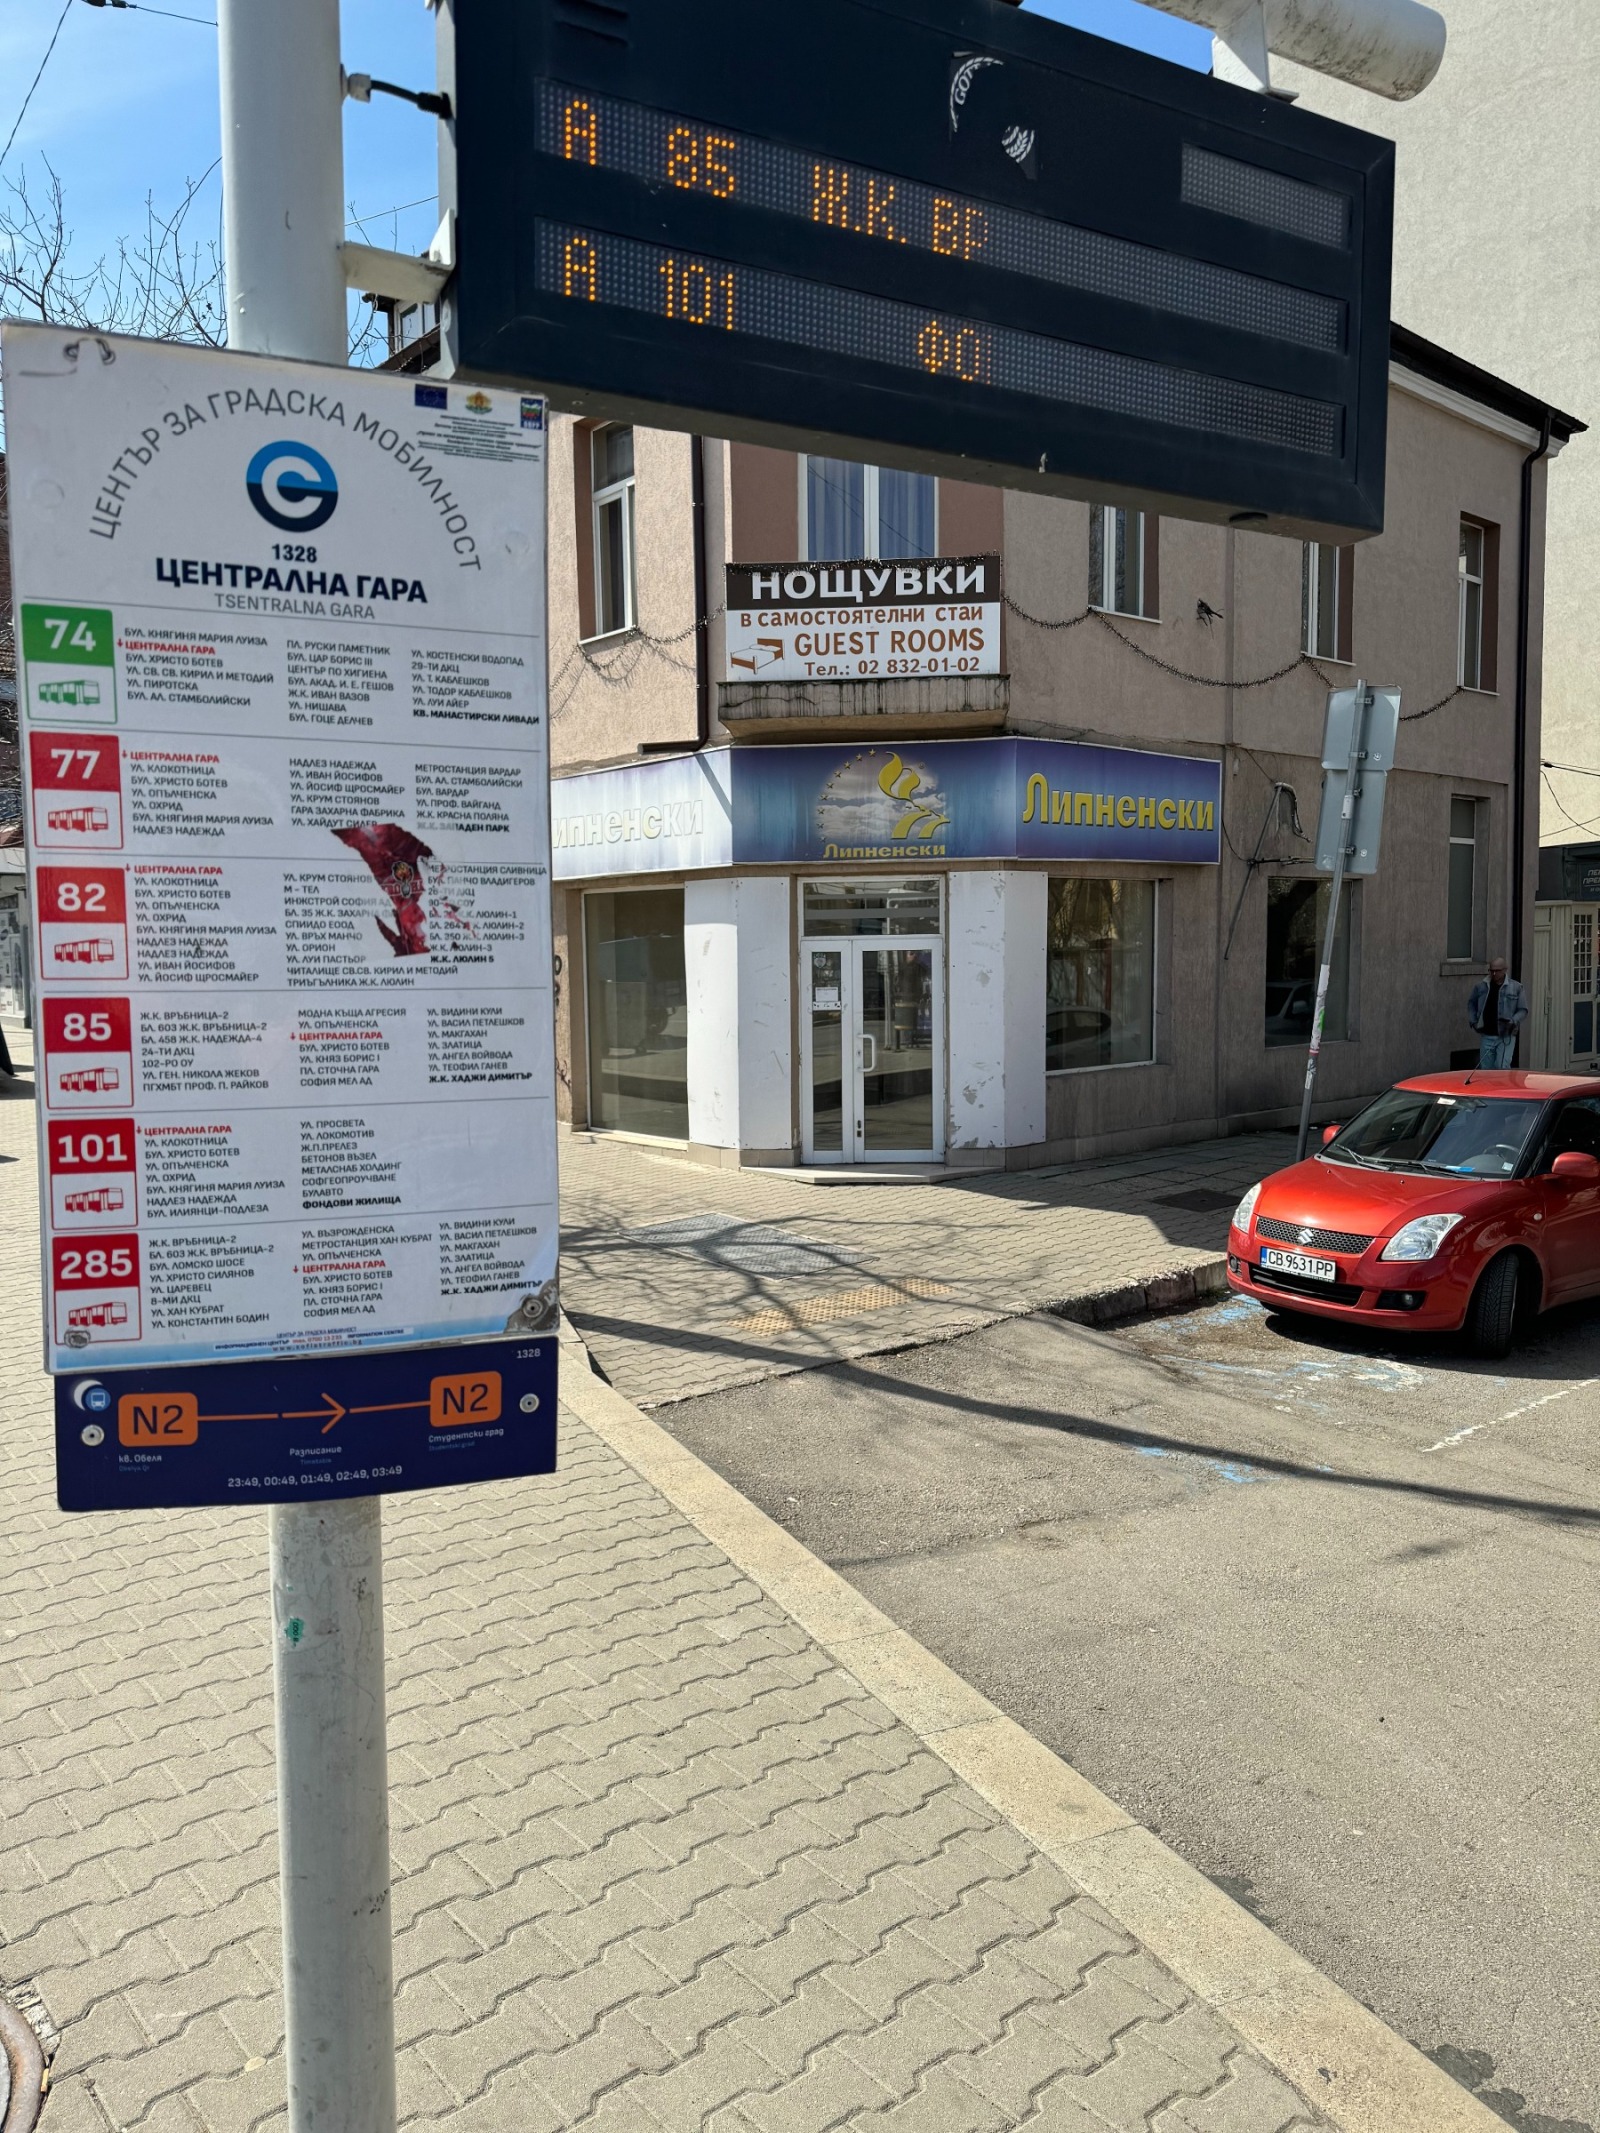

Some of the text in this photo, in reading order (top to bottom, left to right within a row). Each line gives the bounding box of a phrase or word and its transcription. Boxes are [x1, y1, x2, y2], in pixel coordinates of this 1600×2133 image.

[668, 127, 735, 198] 85
[814, 164, 907, 244] Ж.К.
[660, 258, 734, 330] 101
[89, 426, 161, 540] ЦЕНТЪР
[163, 403, 206, 437] ЗА
[207, 388, 346, 427] ГРАДСКА
[352, 411, 482, 573] МОБИЛНОСТ
[271, 543, 318, 564] 1328
[156, 557, 429, 604] ЦЕНТРАЛНА ГАРА
[752, 565, 985, 603] НОЩУВКИ
[214, 592, 376, 620] TSENTRALNA GARA
[740, 605, 983, 627] в самостоятелни стаи
[44, 618, 96, 652] 74
[124, 628, 267, 646] БУЛ. КНЯГИНЯ МАРИЯ ЛУИЗА
[125, 641, 215, 654] ЦЕНТРАЛНА ГАРА
[794, 627, 985, 657] GUEST ROOMS
[125, 653, 223, 667] БУЛ. ХРИСТО БОТЕВ
[804, 656, 980, 676] Тел.: 02 832-01-02
[287, 664, 387, 678] ЦЕНТЪР ПО ХИГИЕНА
[411, 661, 459, 673] 29-ТИ ДКЦ
[413, 709, 539, 724] КВ. МАНАСТИРСКИ ЛИВАДИ
[51, 748, 101, 779] 77
[130, 752, 219, 763] ЦЕНТРАЛНА ГАРА
[289, 758, 376, 770] НАДЛЕЗ НАДЕЖДА
[130, 764, 215, 775] УЛ. КЛОКОТНИЦА
[414, 764, 521, 776] МЕТРОСТАНЦИЯ ВАРДАР
[415, 787, 469, 797] БУЛ. ВАРДАР
[1022, 772, 1214, 832] Липненски
[291, 805, 404, 817] ГАРА ЗАХАРНА ФАБРИКА
[133, 825, 225, 836] НАДЛЕЗ НАДЕЖДА
[552, 800, 704, 849] ипненски
[822, 842, 947, 859] Липненски
[134, 865, 222, 874] ЦЕНТРАЛНА ГАРА
[134, 877, 218, 886] УЛ. КЛОКОТНИЦА
[57, 882, 106, 912] 82
[328, 920, 354, 929] ЕООД
[136, 938, 228, 948] НАДЛЕЗ НАДЕЖДА
[430, 955, 451, 963] Ж.К.
[488, 955, 494, 963] 5
[138, 972, 259, 982] УЛ. ЙОСИФ ЩРОСМАЙЕР
[287, 978, 357, 986] ТРИЪГЪЛНИКА
[359, 978, 378, 986] Ж.К.
[140, 1011, 228, 1020] Ж.К. ВРЪБНИЦА-2
[298, 1008, 406, 1018] МОДНА КЪЩА АГРЕСИЯ
[63, 1012, 112, 1042] 85
[299, 1031, 382, 1040] ЦЕНТРАЛНА ГАРА
[429, 1072, 532, 1083] Ж.К. ХАДЖИ ДИМИТЪР
[184, 1081, 216, 1090] ПРОФ.
[218, 1081, 228, 1090] П.
[230, 1079, 268, 1089] РАЙКОВ
[144, 1125, 231, 1135] ЦЕНТРАЛНА ГАРА
[57, 1133, 128, 1164] 101
[301, 1152, 376, 1163] БЕТОНОВ ВЪЗЕЛ
[301, 1162, 400, 1174] МЕТАЛСНАБ ХОЛДИНГ
[301, 1173, 395, 1186] СОФГЕОПРОУЧВАНЕ
[302, 1188, 343, 1197] БУЛАВТО
[302, 1196, 401, 1209] ФОНДОВИ ЖИЛИЩА
[147, 1204, 268, 1218] БУЛ. ИЛИЯНЦИ-ПОДЛЕЗА
[149, 1235, 236, 1248] Ж.К. ВРЪБНИЦА-2
[301, 1234, 431, 1250] МЕТРОСТАНЦИЯ ХАН КУБРАТ
[60, 1248, 133, 1280] 285
[302, 1260, 385, 1273] ЦЕНТРАЛНА ГАРА
[441, 1280, 542, 1296] Ж.К. ХАДЖИ ДИМИТЪР
[150, 1295, 200, 1305] 8-МИ ДКЦ
[516, 1348, 541, 1359] 1328
[443, 1383, 488, 1415] N2
[132, 1404, 184, 1436] N2
[428, 1428, 504, 1443] Студентски град
[289, 1446, 342, 1457] Разписание
[118, 1454, 162, 1463] кв. Обеля
[227, 1465, 403, 1488] 23:49, 00:49, 01:49, 02:49, 03:49
